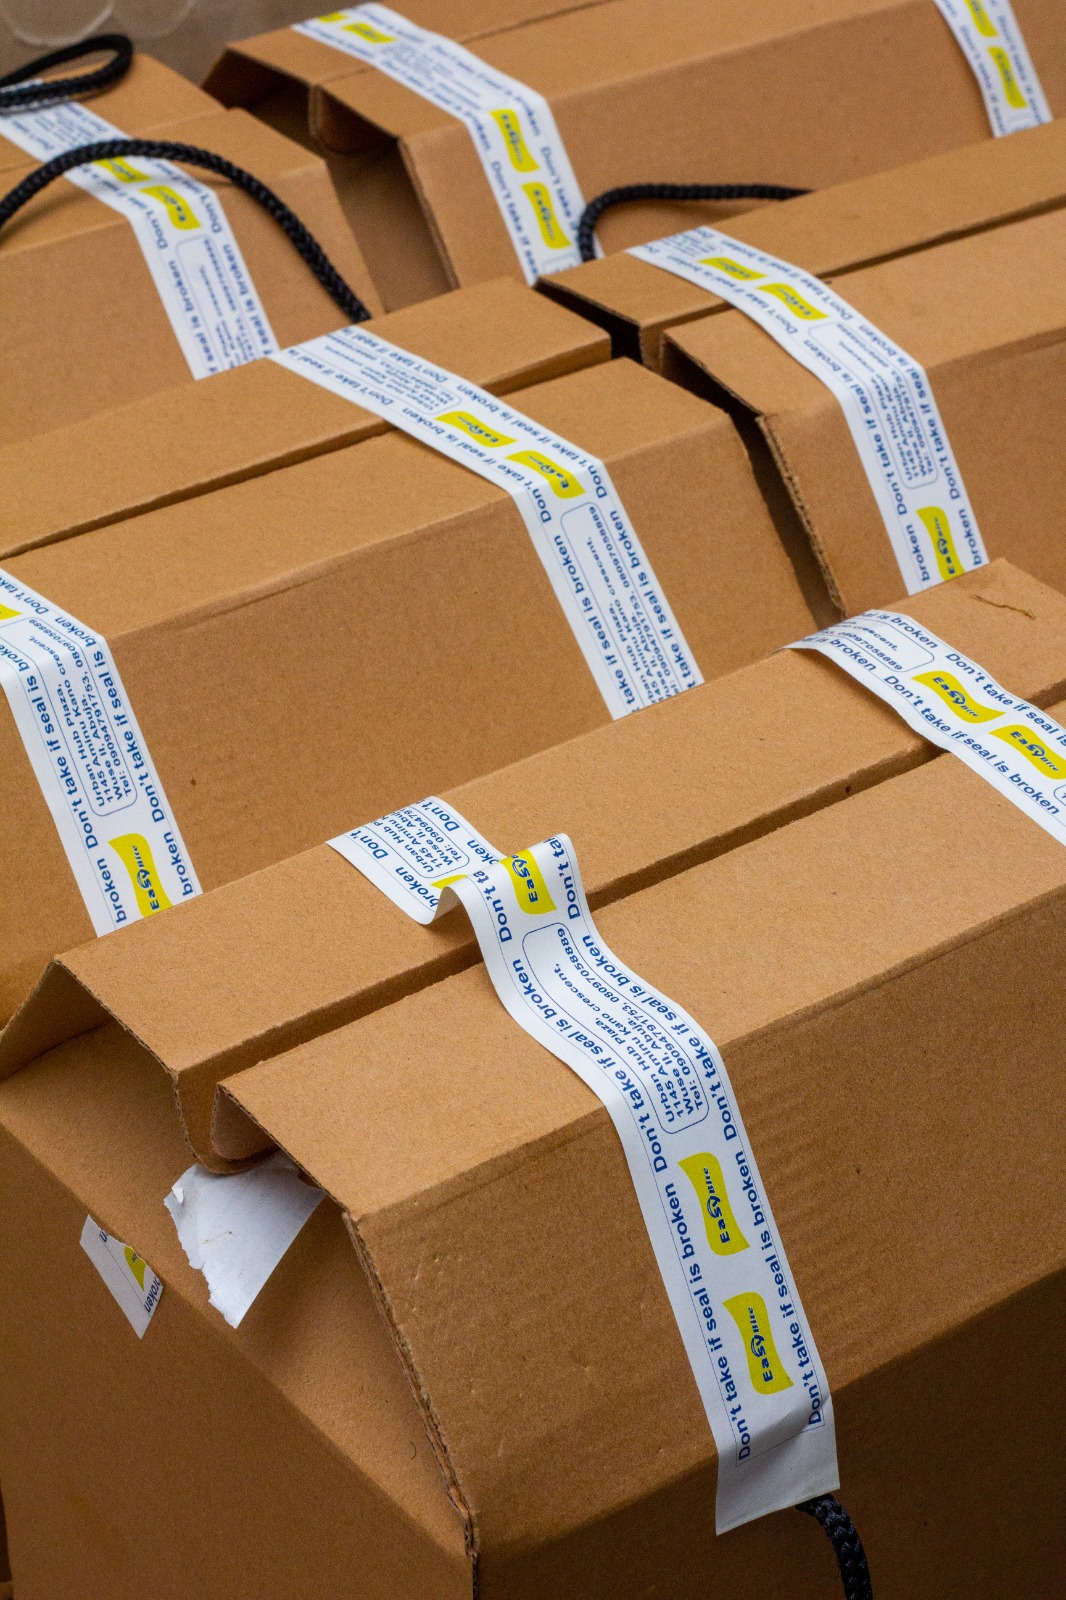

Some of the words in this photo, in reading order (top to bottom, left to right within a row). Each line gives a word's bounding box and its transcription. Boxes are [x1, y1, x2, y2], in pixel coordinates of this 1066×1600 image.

[866, 420, 877, 429] if
[920, 404, 931, 413] if
[552, 443, 579, 460] take
[874, 434, 891, 467] take
[928, 419, 944, 452] take
[497, 465, 525, 481] take
[579, 460, 607, 499] Don't
[939, 456, 960, 500] Don't
[525, 481, 552, 523] Don't
[886, 472, 907, 515] Don't
[610, 511, 640, 568] broken
[906, 524, 930, 582] broken
[959, 509, 982, 565] broken
[554, 535, 585, 594] broken
[638, 572, 649, 587] is
[0, 577, 18, 593] tak
[15, 592, 49, 615] Don't
[582, 597, 593, 613] is
[615, 599, 632, 633] Kano
[644, 590, 666, 624] seal
[29, 619, 83, 668] 08097058889
[55, 617, 97, 647] broken
[588, 616, 610, 650] seal
[661, 629, 673, 639] if
[29, 637, 66, 676] crescent,
[93, 651, 106, 667] is
[605, 654, 617, 665] if
[627, 645, 641, 672] Hub
[631, 636, 653, 677] Aminu
[671, 643, 691, 678] take
[27, 675, 39, 692] is
[98, 672, 121, 709] seal
[615, 670, 635, 704] take
[890, 617, 938, 648] broken
[945, 653, 986, 683] Don't
[983, 684, 1013, 705] take
[1026, 712, 1059, 734] seal
[31, 696, 54, 734] seal
[57, 684, 75, 727] Plaza,
[64, 680, 81, 717] Kano
[81, 698, 101, 739] Abuja.
[83, 671, 121, 767] 09094791753,
[114, 714, 128, 726] if
[829, 639, 876, 671] broken
[884, 675, 924, 706] Don't
[921, 708, 951, 732] take
[951, 731, 967, 739] if
[963, 734, 997, 760] seal
[994, 760, 1009, 773] is
[1008, 773, 1060, 814] broken
[46, 740, 61, 752] if
[73, 731, 87, 760] Hub
[79, 721, 101, 766] Aminu
[124, 731, 144, 769] take
[57, 756, 77, 795] take
[86, 761, 105, 807] Urban
[97, 770, 113, 802] 1145
[105, 760, 123, 800] Wuse
[119, 775, 131, 796] Tel:
[138, 772, 165, 823] Don't
[72, 798, 98, 849] Don't
[383, 826, 404, 843] Hub
[389, 819, 421, 845] Aminu
[421, 802, 460, 831] Don't
[350, 830, 389, 859] Don't
[404, 844, 434, 872] Urban
[419, 847, 443, 868] 1145
[426, 839, 453, 866] Wuse
[446, 847, 462, 861] Tel:
[163, 832, 193, 896] broken
[97, 858, 127, 923] broken
[558, 862, 581, 919] Don't
[484, 886, 512, 943] Don't
[557, 928, 619, 1003] 08097058889
[582, 935, 630, 986] broken
[512, 959, 557, 1019] broken
[554, 963, 601, 1012] crescent,
[629, 986, 646, 1003] is
[556, 1019, 572, 1032] is
[601, 1013, 635, 1035] Kano
[643, 997, 677, 1021] seal
[671, 1018, 687, 1035] if
[567, 1031, 603, 1055] seal
[595, 1018, 626, 1045] Plaza,
[622, 1002, 691, 1076] 09094791753,
[628, 1016, 661, 1049] Abuja.
[597, 1057, 616, 1069] if
[627, 1046, 650, 1071] Hub
[632, 1037, 668, 1076] Aminu
[662, 1052, 672, 1065] II,
[689, 1037, 716, 1079] take
[615, 1070, 645, 1110] take
[651, 1074, 675, 1123] Urban
[665, 1080, 684, 1117] 1145
[673, 1069, 694, 1115] Wuse
[689, 1080, 703, 1111] Tel:
[709, 1081, 737, 1141] Don't
[638, 1113, 668, 1173] Don't
[735, 1151, 765, 1226] broken
[665, 1183, 695, 1259] broken
[761, 1230, 772, 1250] is
[689, 1263, 702, 1284] is
[765, 1254, 788, 1298] seal
[693, 1287, 716, 1331] seal
[780, 1303, 794, 1318] if
[707, 1337, 723, 1352] if
[790, 1322, 810, 1367] take
[718, 1356, 737, 1402] take
[802, 1370, 824, 1425] Don't
[730, 1404, 754, 1462] Don't
